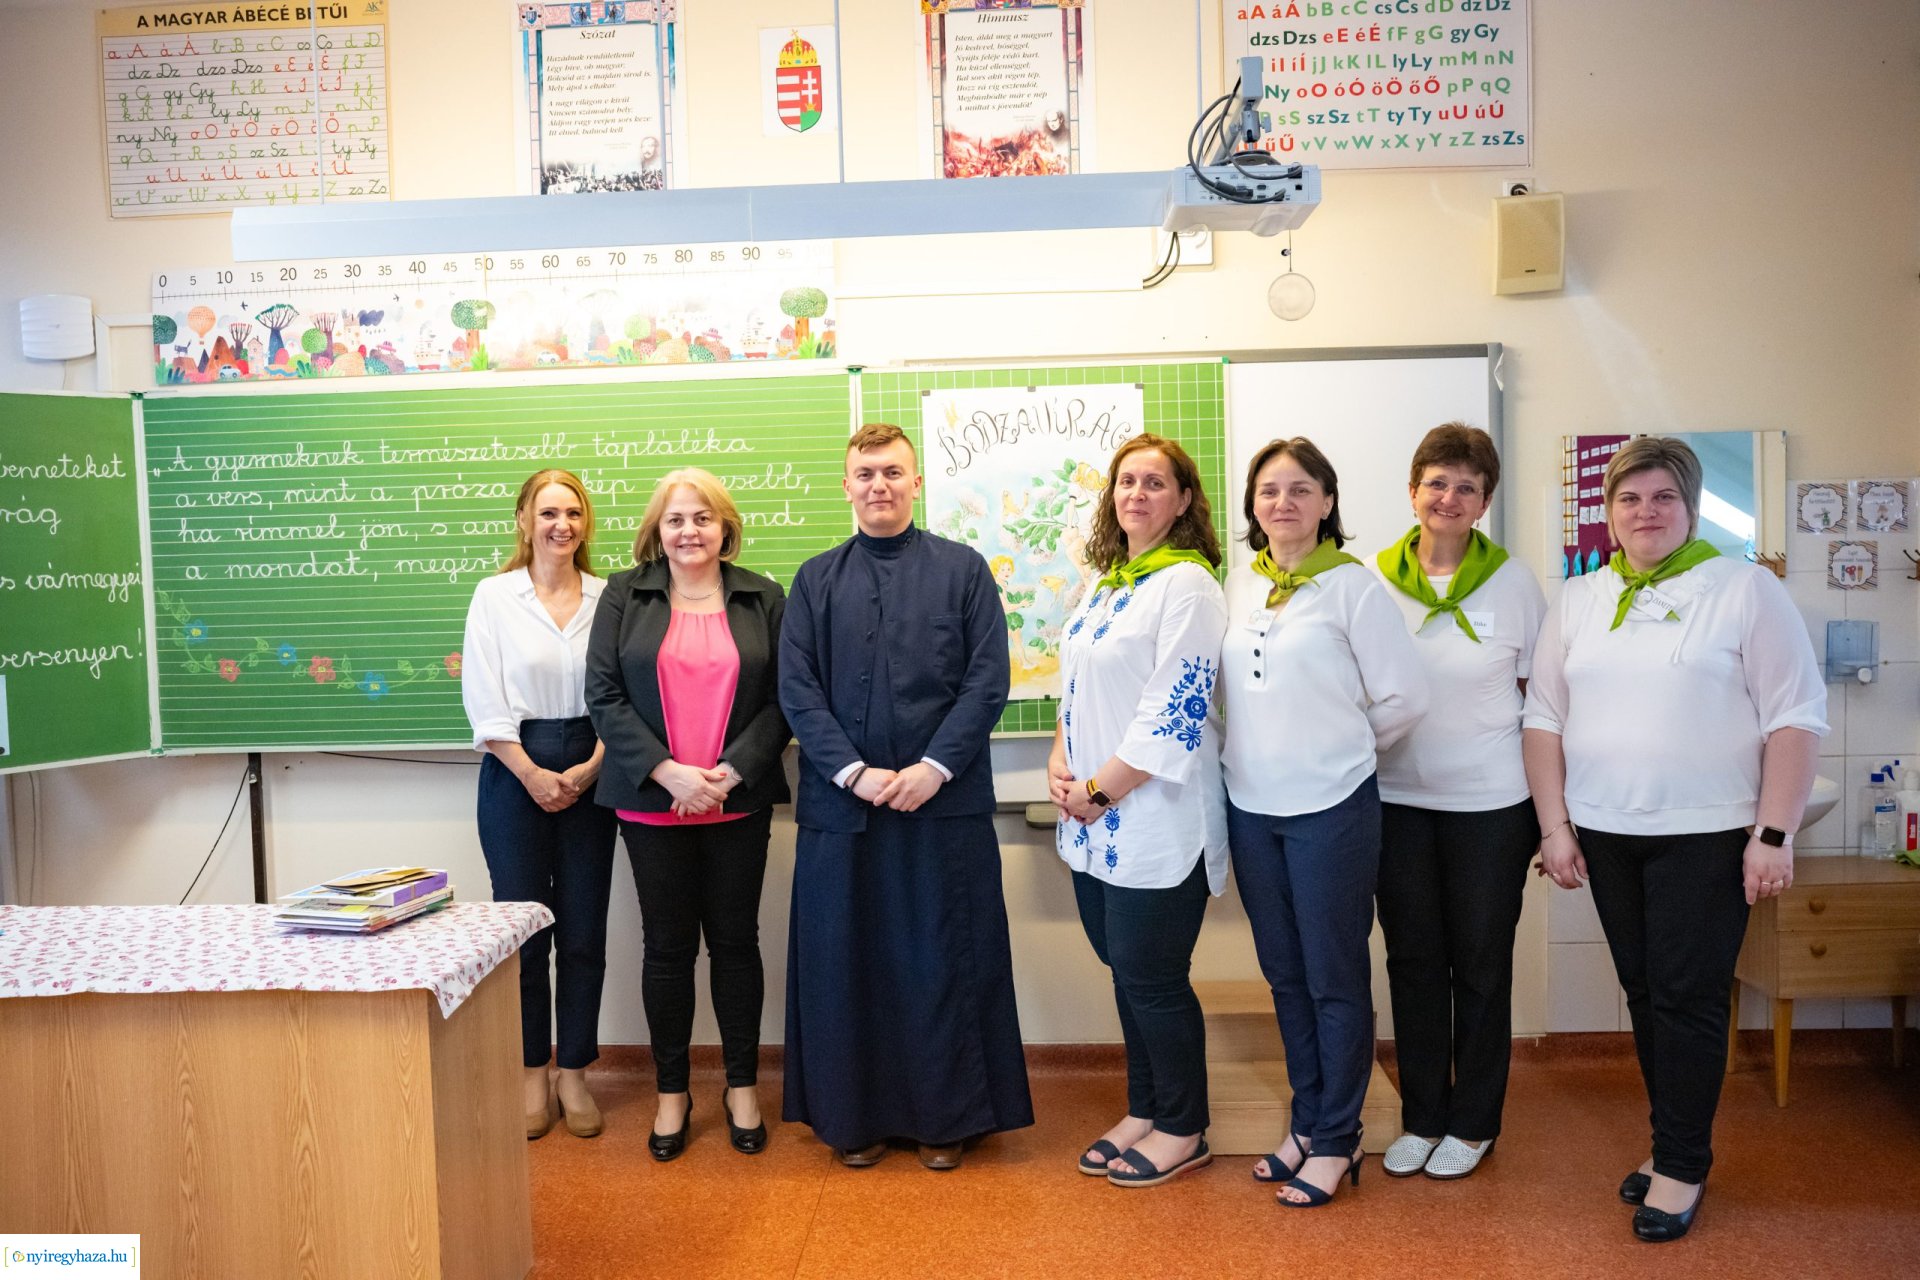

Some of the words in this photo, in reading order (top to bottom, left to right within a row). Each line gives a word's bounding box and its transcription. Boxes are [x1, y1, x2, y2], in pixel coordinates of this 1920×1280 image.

[154, 11, 227, 27] MAGYAR
[233, 5, 290, 23] ÁBÉCÉ
[189, 275, 197, 286] 5
[217, 270, 233, 285] 10
[250, 271, 264, 283] 15
[280, 267, 297, 282] 20
[313, 268, 328, 280] 25
[344, 264, 362, 278] 30
[377, 264, 392, 277] 35
[408, 260, 427, 275] 40
[443, 261, 458, 273] 45
[474, 257, 494, 271] 50
[509, 257, 525, 270] 55
[541, 254, 560, 269] 60
[576, 255, 591, 268] 65
[608, 252, 626, 266] 70
[643, 253, 658, 265] 75
[674, 249, 693, 264] 80
[710, 250, 725, 262] 85
[742, 246, 761, 261] 90
[205, 440, 364, 481] gyermeknek
[379, 431, 578, 464] természetesebb
[592, 428, 755, 468] tápláléka
[175, 494, 197, 507] a
[207, 491, 273, 510] vers,
[284, 477, 356, 503] mint
[370, 487, 393, 501] a
[411, 472, 514, 512] próza
[178, 517, 222, 542] ha
[235, 513, 345, 542] rímmel
[360, 518, 418, 550] jön,
[431, 522, 448, 535] s
[25, 561, 141, 602] vármegyei
[185, 565, 208, 580] a
[225, 549, 377, 583] mondat,
